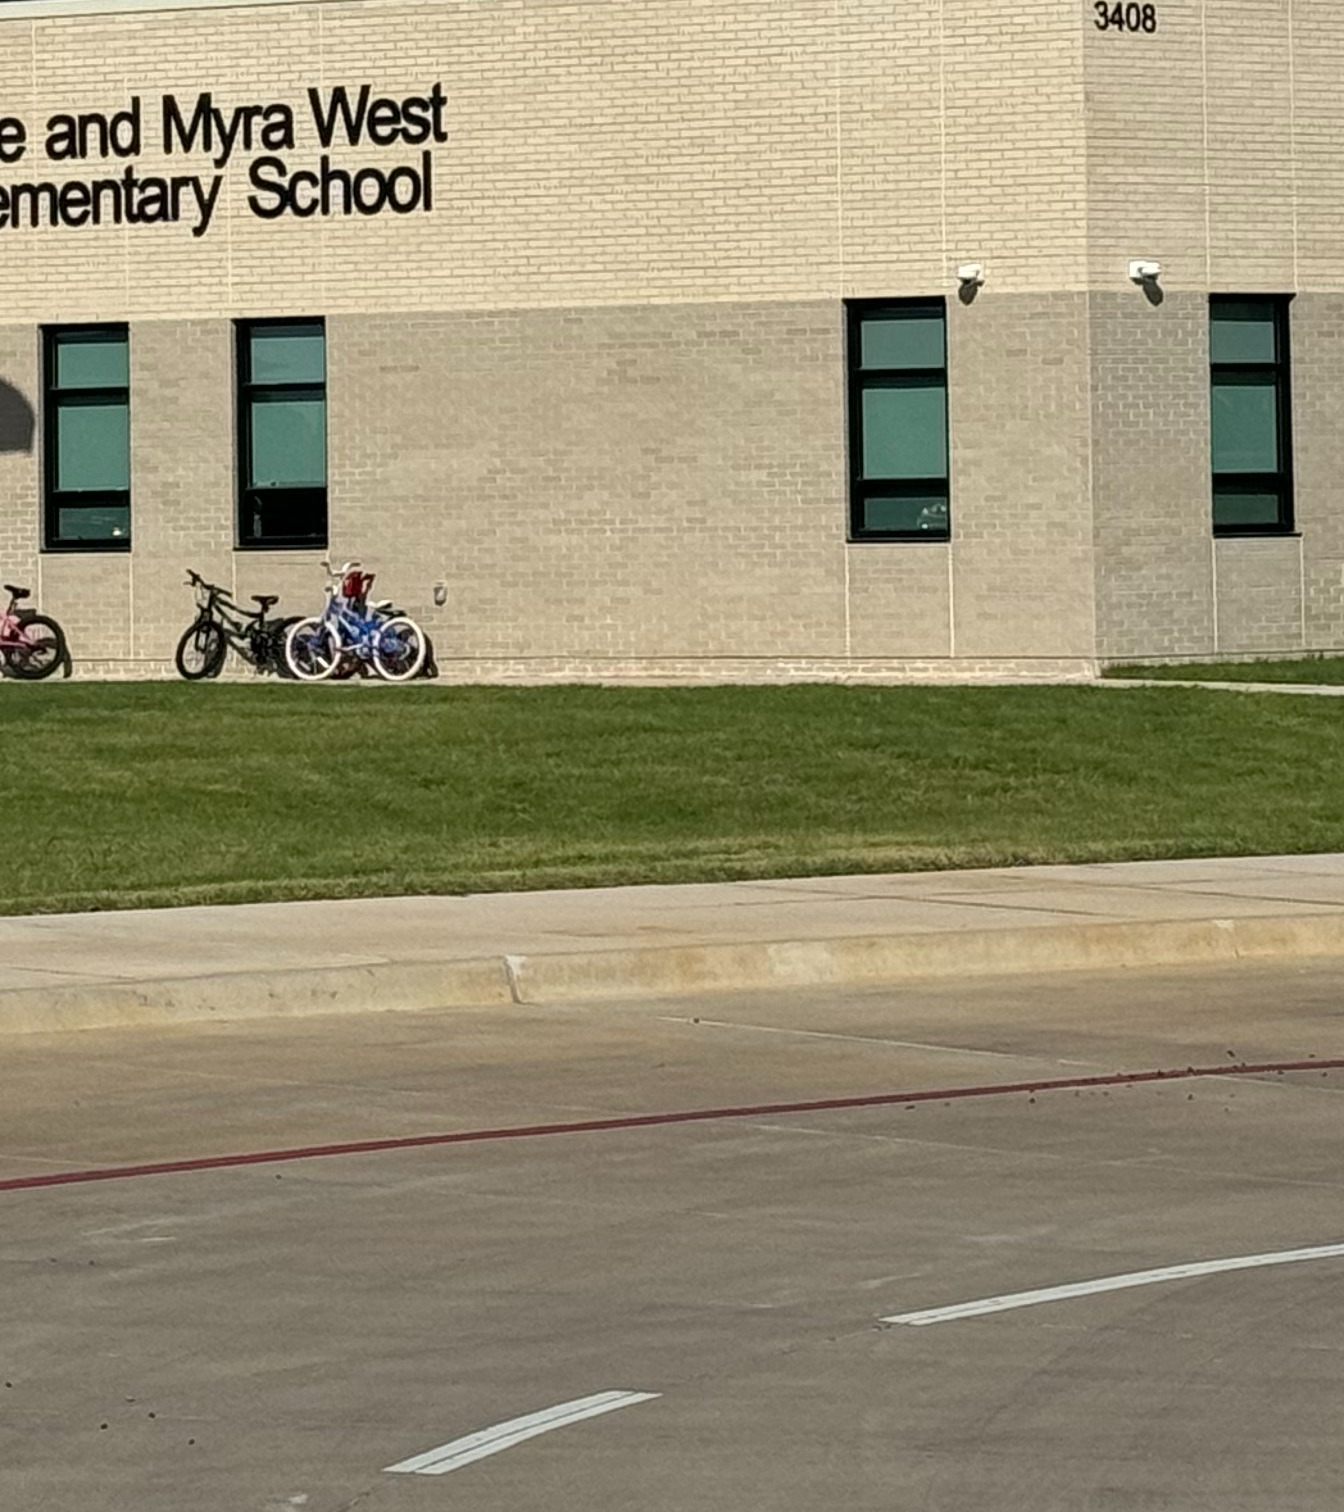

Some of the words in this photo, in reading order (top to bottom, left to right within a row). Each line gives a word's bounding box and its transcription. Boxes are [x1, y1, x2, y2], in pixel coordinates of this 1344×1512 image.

[1094, 1, 1156, 33] 3408
[44, 96, 141, 159] and
[162, 92, 295, 168] Myra
[307, 81, 448, 148] West
[247, 150, 433, 219] School
